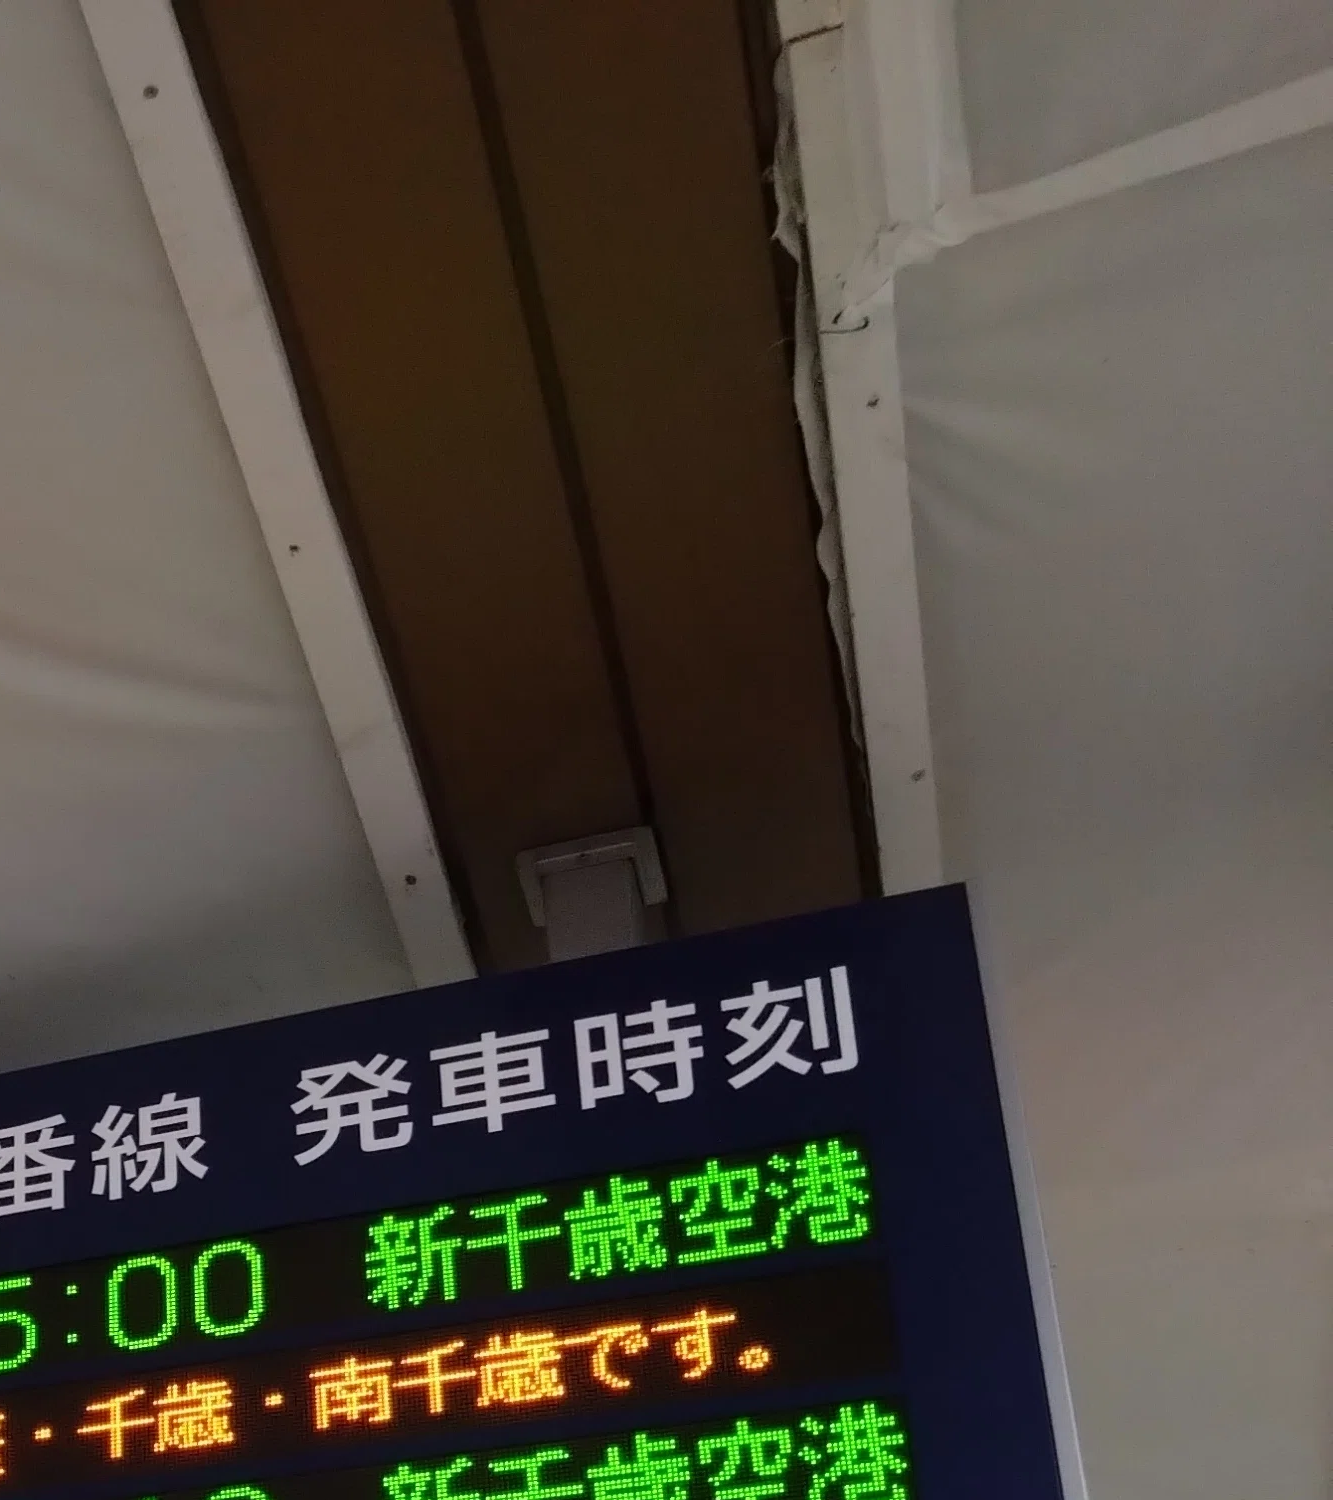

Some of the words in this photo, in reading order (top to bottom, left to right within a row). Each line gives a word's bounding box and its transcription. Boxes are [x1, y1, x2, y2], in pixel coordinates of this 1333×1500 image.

[290, 966, 859, 1165] 発車時刻
[363, 1140, 871, 1311] 新千歳空港
